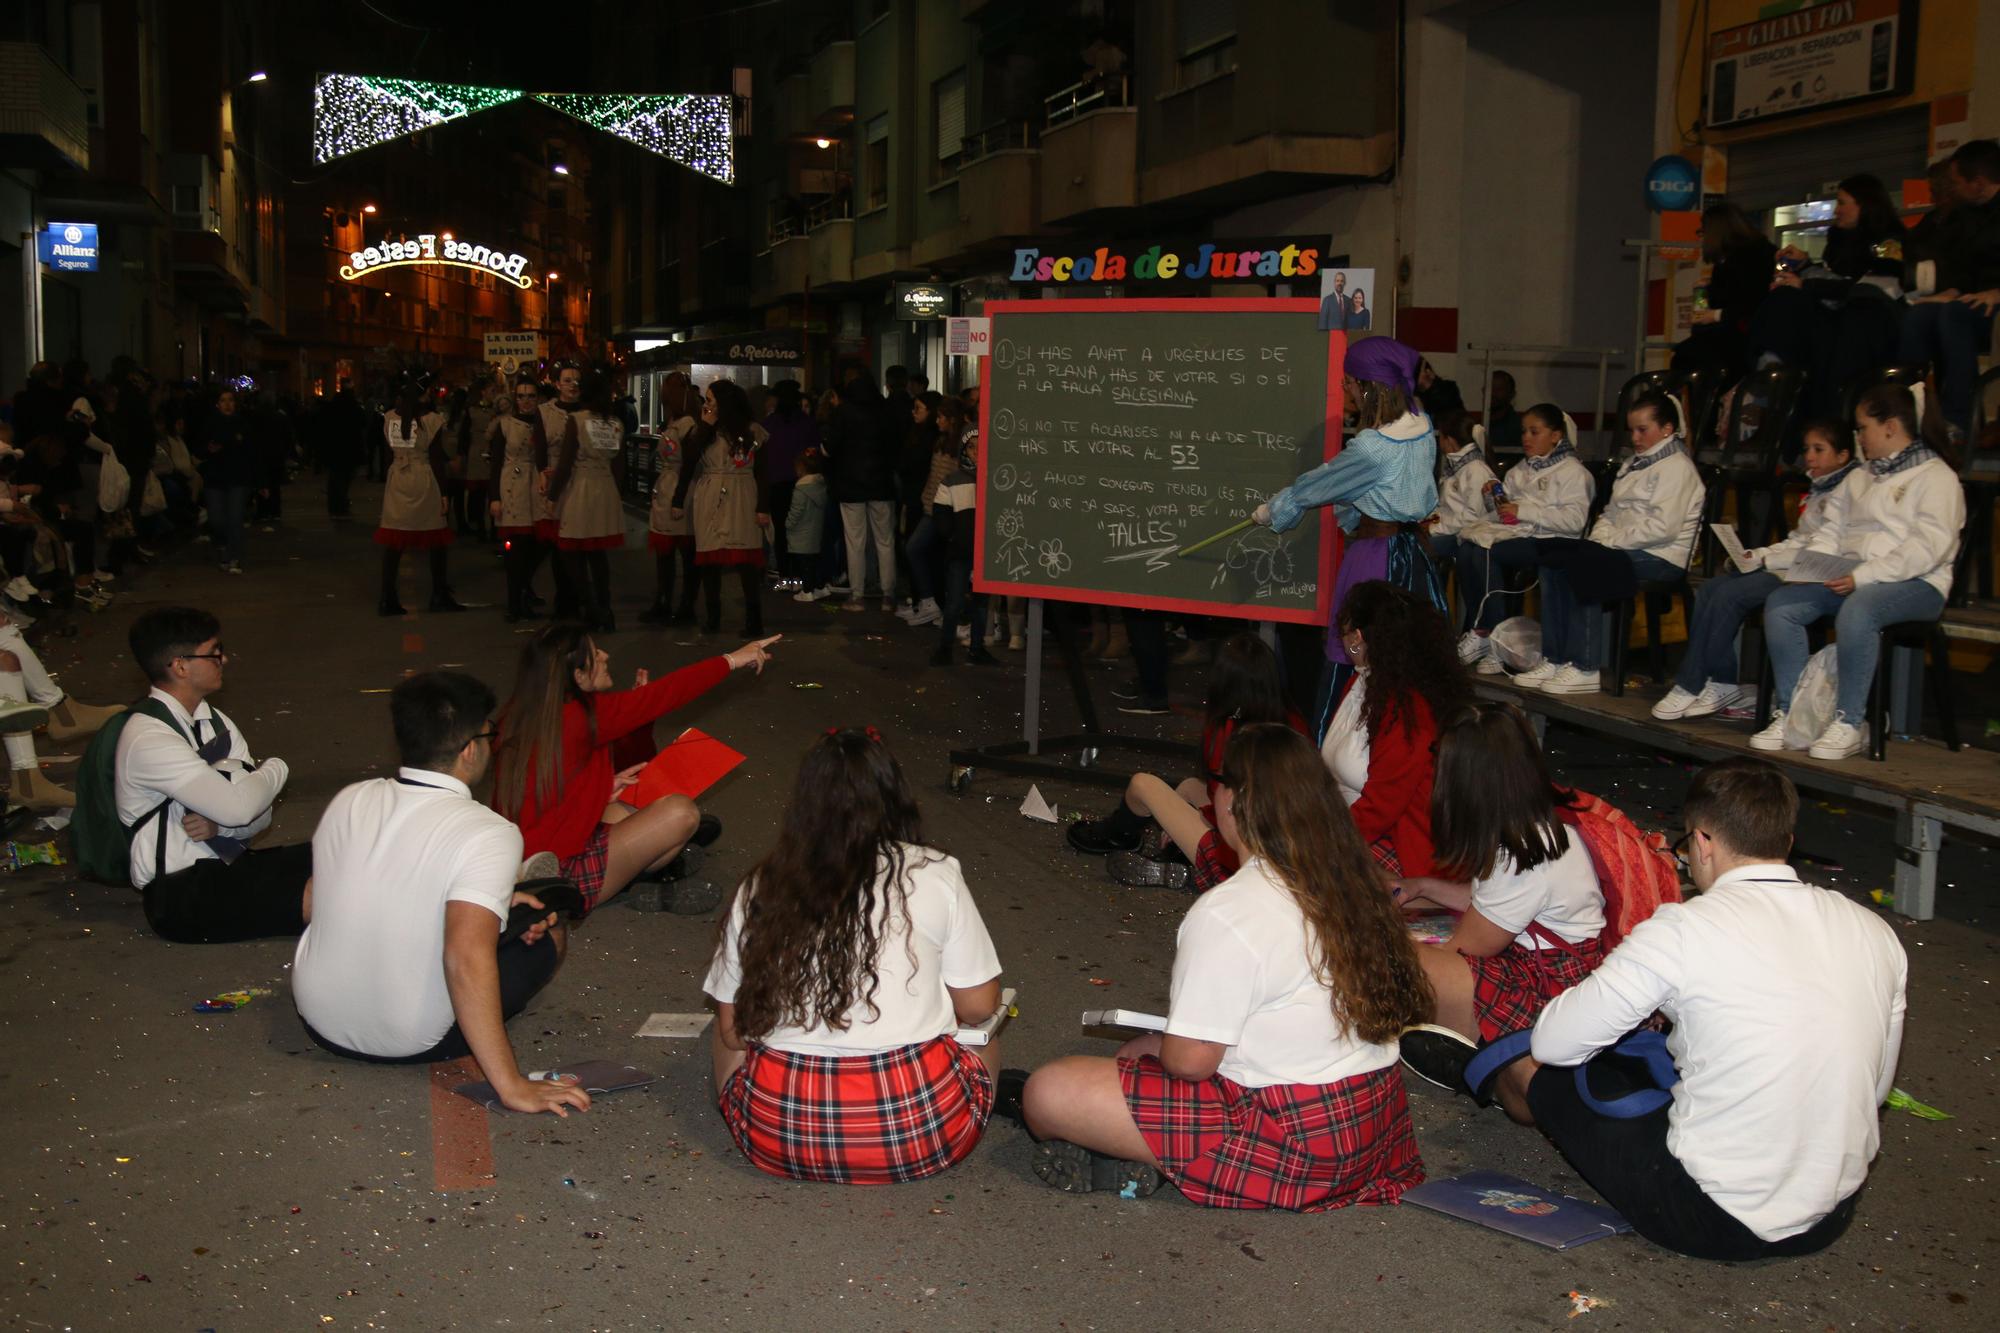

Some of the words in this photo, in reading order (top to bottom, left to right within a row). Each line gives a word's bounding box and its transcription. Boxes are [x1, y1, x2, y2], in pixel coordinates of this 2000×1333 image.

[1649, 180, 1695, 192] DIGI
[52, 243, 97, 257] Allianz
[58, 258, 89, 270] Seguros
[1008, 247, 1127, 282] Escola
[1133, 245, 1180, 280] de
[1184, 243, 1319, 280] Jurats
[505, 334, 534, 342] GRAN
[970, 331, 987, 343] NO
[1015, 346, 1031, 361] SI
[1038, 345, 1073, 361] HAS
[1088, 344, 1127, 361] ANAT
[1141, 347, 1153, 363] A
[1260, 347, 1288, 362] DE
[1017, 363, 1035, 377] LA
[1109, 368, 1138, 383] HAS
[1148, 370, 1165, 383] DE
[1173, 371, 1219, 384] VOTAR
[1256, 374, 1269, 386] O
[1018, 380, 1027, 391] A
[1036, 381, 1053, 392] LA
[1061, 381, 1102, 394] FALLA
[1112, 387, 1199, 405] SALESIANA
[1018, 419, 1028, 432] SI
[1035, 420, 1052, 432] NO
[1061, 420, 1080, 432] TE
[1169, 430, 1183, 441] NI
[1191, 430, 1201, 441] A
[1206, 431, 1221, 443] LA
[1225, 431, 1248, 443] DE
[1019, 438, 1048, 455] HAS
[1062, 440, 1080, 454] DE
[1088, 440, 1135, 457] VOTAR
[1144, 446, 1163, 460] AL
[1170, 445, 1200, 466] 53
[1165, 482, 1207, 497] TENEN
[1218, 486, 1235, 501] LES
[1048, 497, 1073, 510] QUE
[1081, 499, 1098, 513] JA
[1146, 503, 1178, 517] VOTA
